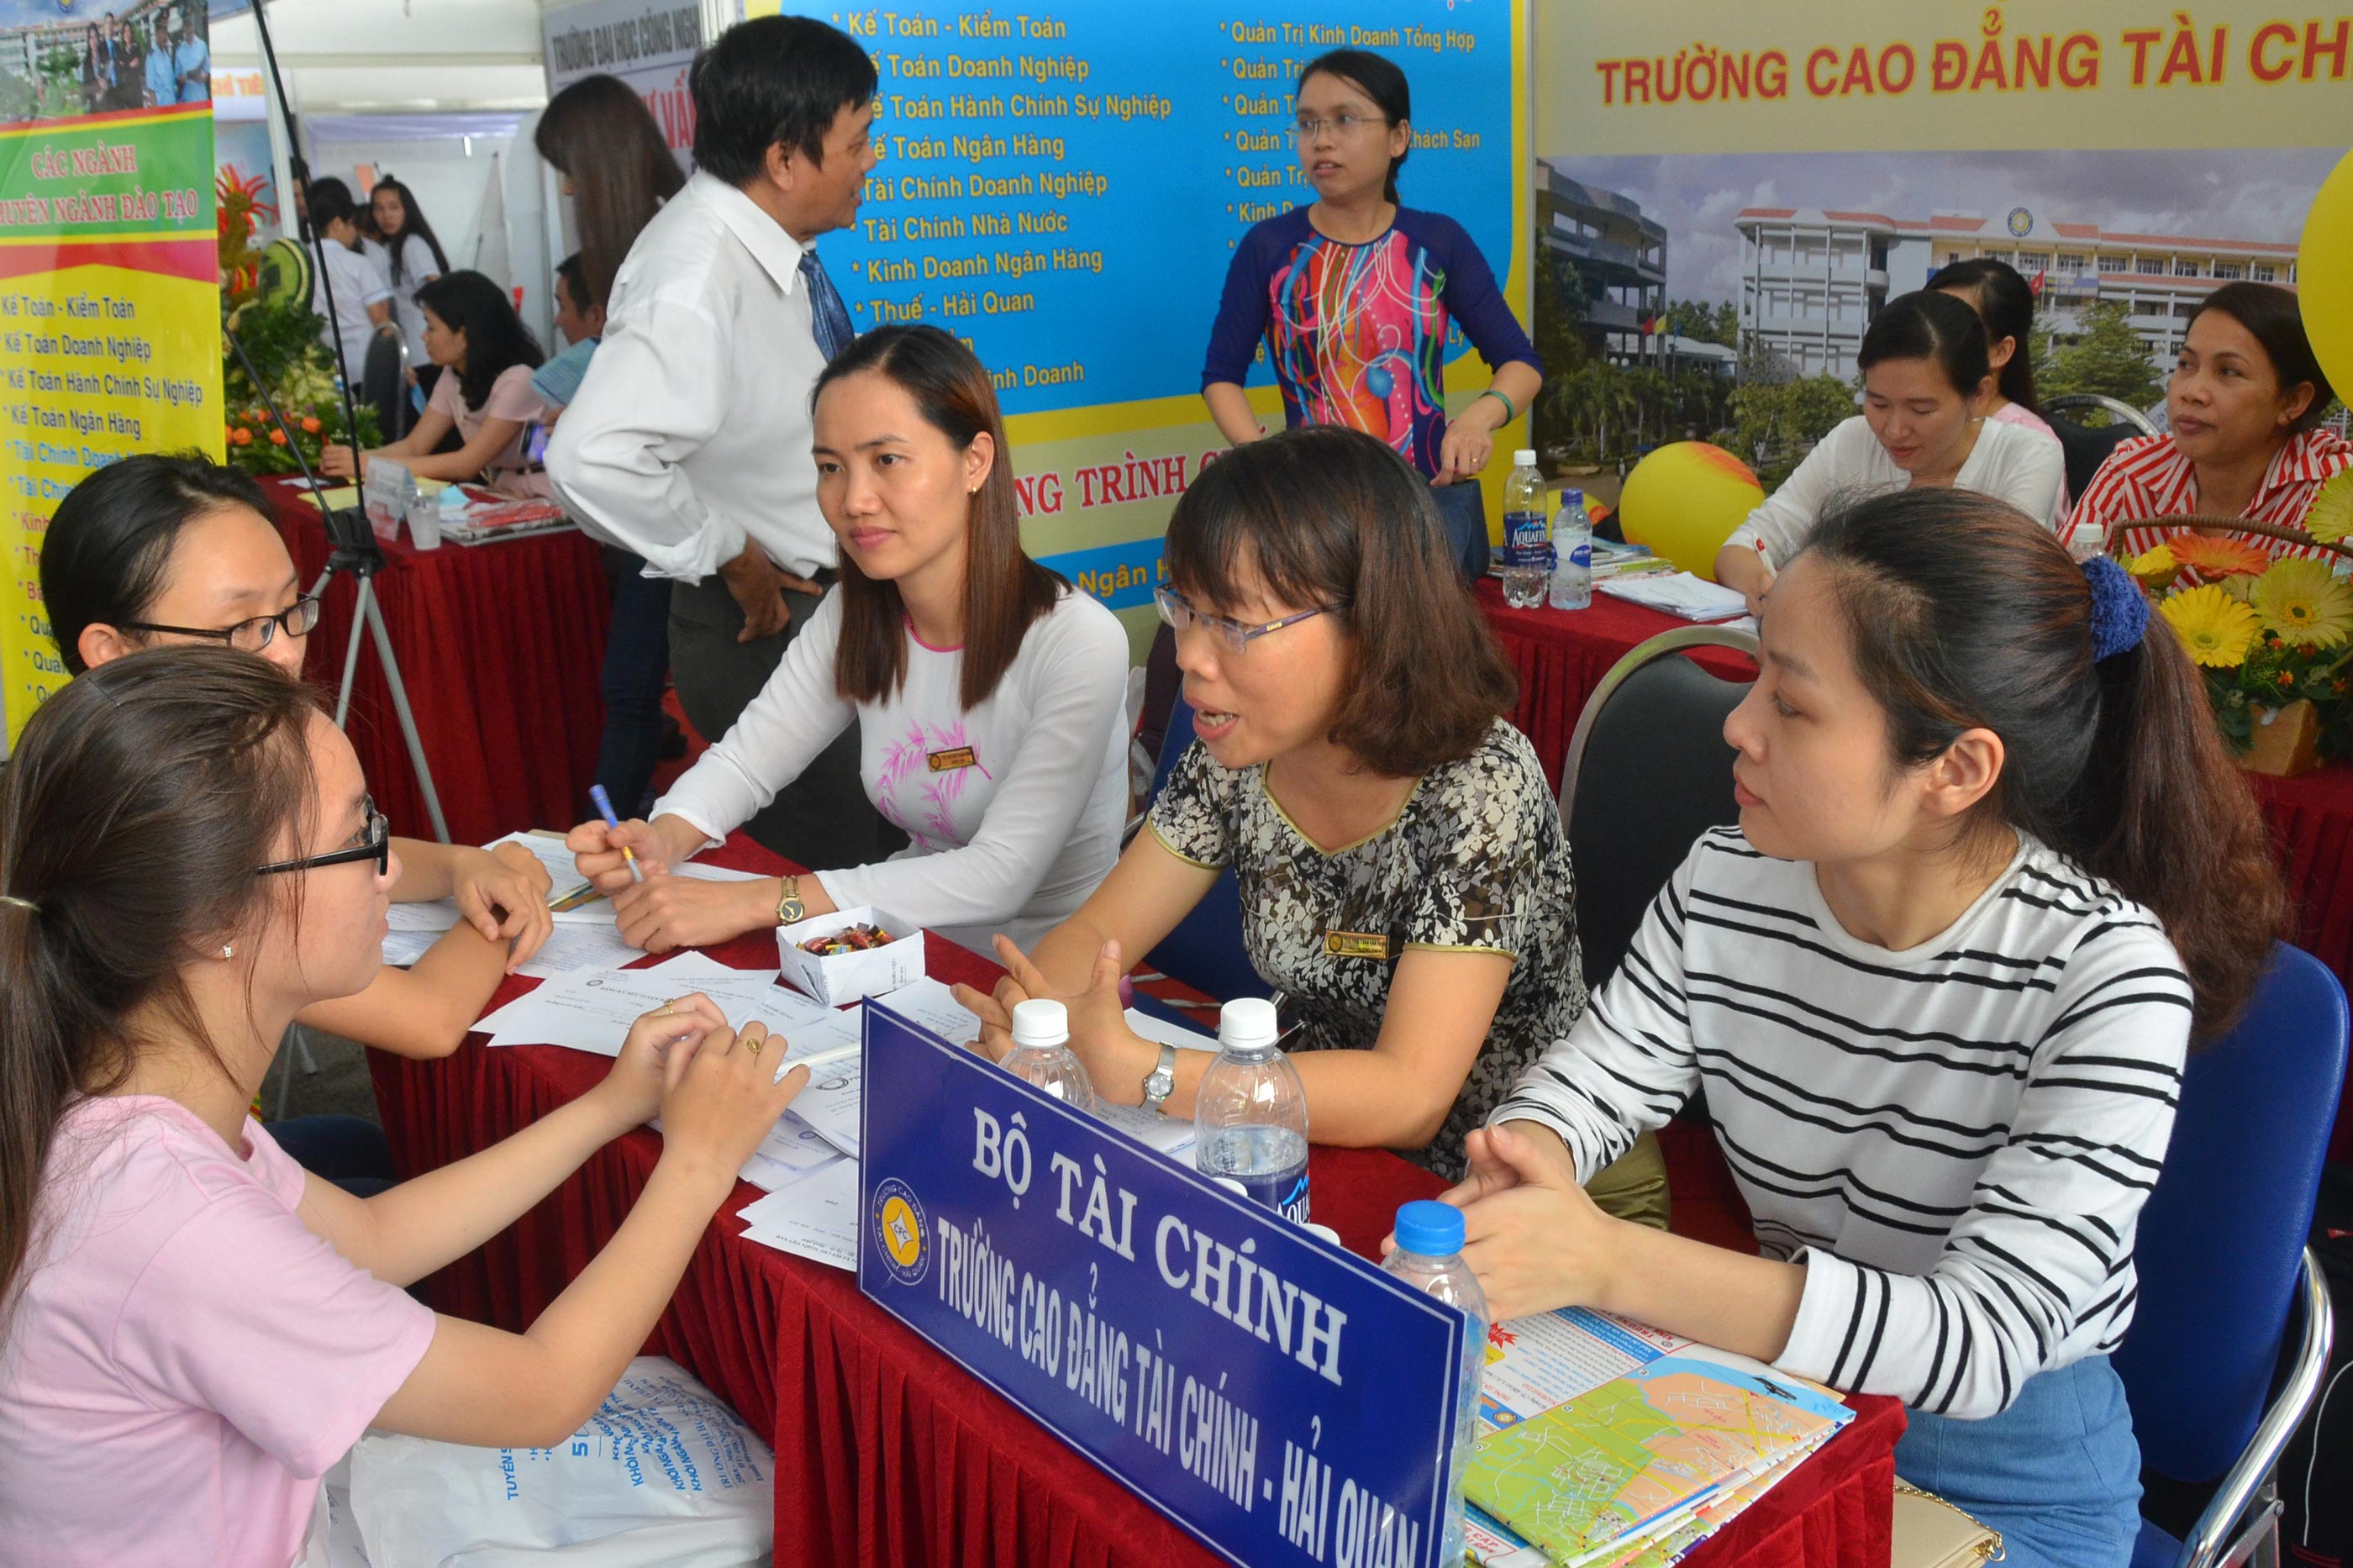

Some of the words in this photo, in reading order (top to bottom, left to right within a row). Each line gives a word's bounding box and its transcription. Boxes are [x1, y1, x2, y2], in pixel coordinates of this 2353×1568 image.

[848, 9, 878, 36] Kế
[884, 13, 938, 36] Toán
[958, 9, 1010, 38] Kiểm
[1018, 15, 1066, 39] Toán
[1231, 20, 1277, 43] Quản
[1282, 23, 1304, 47] Trị
[1309, 24, 1345, 45] Kinh
[1350, 25, 1399, 46] Doanh
[1403, 23, 1442, 52] Tổng
[1445, 29, 1476, 53] Hợp
[887, 54, 940, 77] Toán
[947, 54, 1013, 77] Doanh
[1019, 55, 1089, 82] Nghiệp
[1233, 55, 1277, 79] Quản
[1596, 41, 1788, 105] TRƯỜNG
[1805, 43, 1916, 97] CAO
[1932, 8, 2101, 92] ĐẲNG
[2121, 13, 2228, 86] TÀI
[2248, 18, 2353, 82] CH
[890, 95, 943, 118] Toán
[950, 94, 1004, 118] Hành
[1011, 93, 1069, 117] Chính
[1075, 94, 1100, 122] Sự
[1106, 94, 1171, 121] Nghiệp
[1234, 93, 1279, 115] Quản
[893, 136, 946, 160] Toán
[952, 134, 1006, 163] Ngân
[1013, 134, 1065, 161] Hàng
[1236, 129, 1280, 151] Quản
[1409, 128, 1449, 149] hách
[1453, 129, 1481, 151] Sạn
[32, 144, 67, 179] CÁC
[72, 139, 137, 176] NGÀNH
[864, 176, 894, 202] Tài
[901, 175, 962, 201] Chính
[969, 173, 1033, 198] Doanh
[1040, 171, 1108, 200] Nghiệp
[1237, 163, 1281, 187] Quản
[54, 188, 118, 224] NGÀNH
[121, 185, 157, 221] ĐÀO
[163, 189, 198, 224] TẠO
[1239, 201, 1277, 222] Kinh
[863, 218, 898, 243] Tài
[903, 215, 965, 240] Chính
[971, 213, 1011, 237] Nhà
[1018, 210, 1068, 234] Nước
[867, 257, 916, 282] Kinh
[924, 254, 988, 280] Doanh
[995, 250, 1046, 278] Ngân
[1052, 248, 1103, 273] Hàng
[21, 296, 55, 317] Toán
[66, 292, 100, 318] Kiểm
[103, 296, 135, 318] Toán
[870, 293, 924, 323] Thuế
[943, 291, 976, 318] Hải
[982, 292, 1034, 314] Quan
[24, 333, 59, 355] Toán
[61, 334, 103, 356] Doanh
[108, 335, 151, 364] Nghiệp
[29, 370, 61, 392] Toán
[66, 372, 101, 394] Hành
[104, 371, 141, 397] Chính
[164, 377, 203, 408] Nghiệp
[987, 367, 1018, 390] inh
[1024, 360, 1084, 387] Doanh
[31, 406, 66, 429] Toán
[70, 409, 104, 436] Ngân
[108, 412, 141, 441] Hàng
[1075, 450, 1187, 508] TRÌNH
[1078, 564, 1148, 597] Ngân
[1277, 1192, 1309, 1224] AQUA
[893, 1223, 908, 1240] CFC
[972, 1107, 1032, 1209] BỘ
[1050, 1153, 1137, 1262] TÀI
[1155, 1214, 1347, 1386] CHÍNH
[938, 1216, 1015, 1350] TRƯỜNG
[1020, 1271, 1062, 1378] CAO
[1066, 1261, 1129, 1428] ĐẲNG
[1135, 1328, 1175, 1456] TÀI
[1179, 1371, 1259, 1513] CHÍNH
[1278, 1413, 1332, 1564] HẢI
[1334, 1477, 1419, 1568] QUAN
